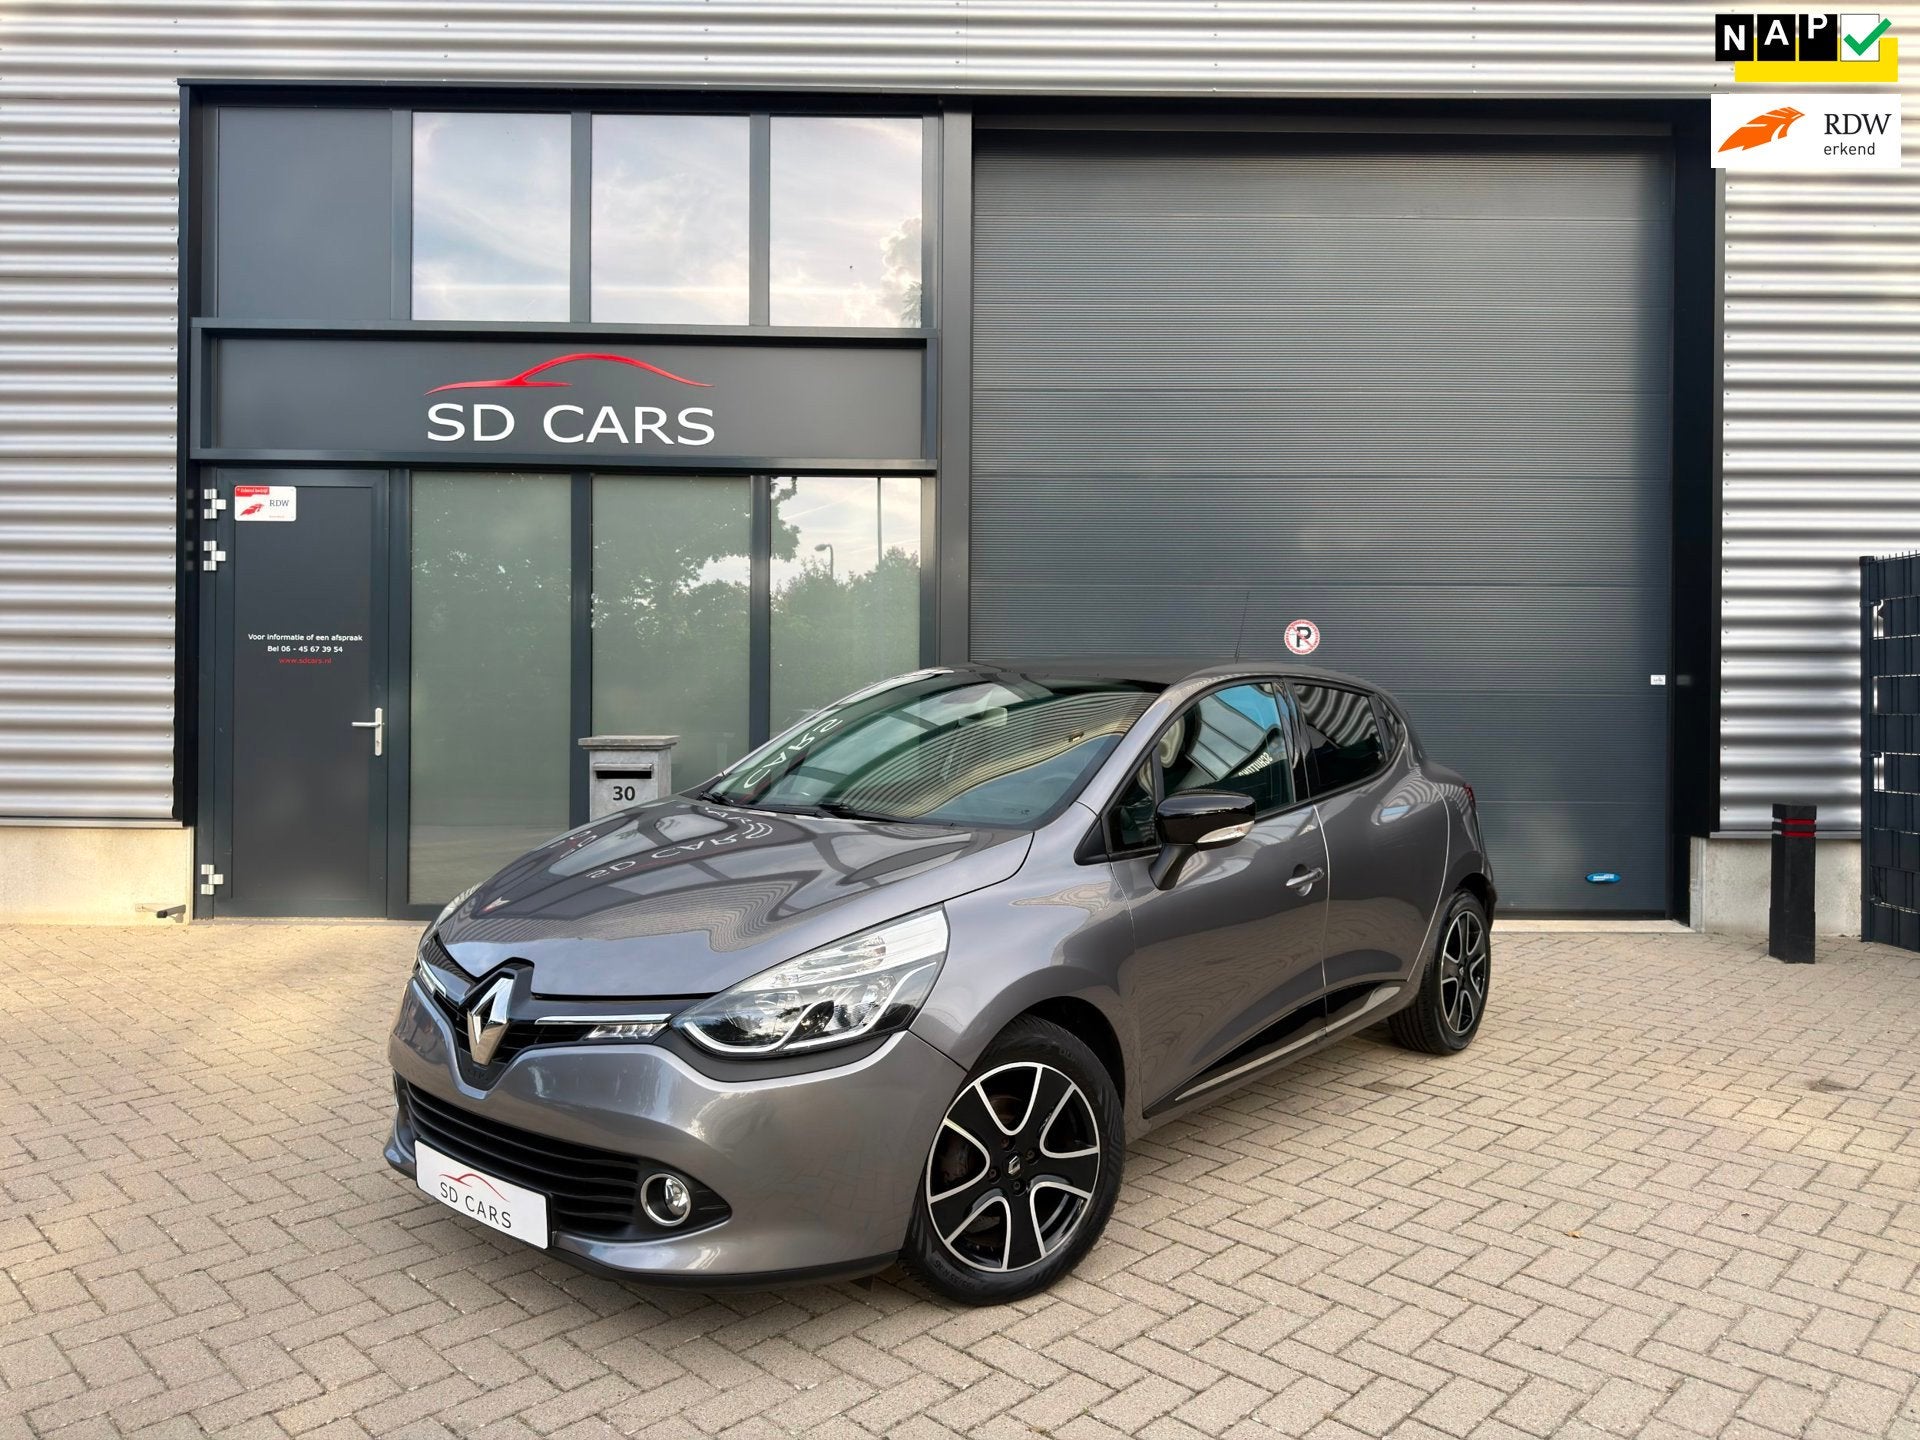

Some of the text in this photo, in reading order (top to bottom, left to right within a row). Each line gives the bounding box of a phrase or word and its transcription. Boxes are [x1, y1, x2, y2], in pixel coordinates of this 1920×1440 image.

[426, 402, 716, 446] SD CARS
[269, 499, 290, 507] RDW
[248, 633, 265, 641] Voor
[267, 633, 304, 641] informatie
[306, 633, 314, 641] of
[331, 634, 363, 642] afspraak
[310, 645, 320, 653] 67
[279, 657, 332, 665] www.sdcars.nl
[612, 785, 636, 802] 30
[440, 1181, 512, 1229] SD CARS
